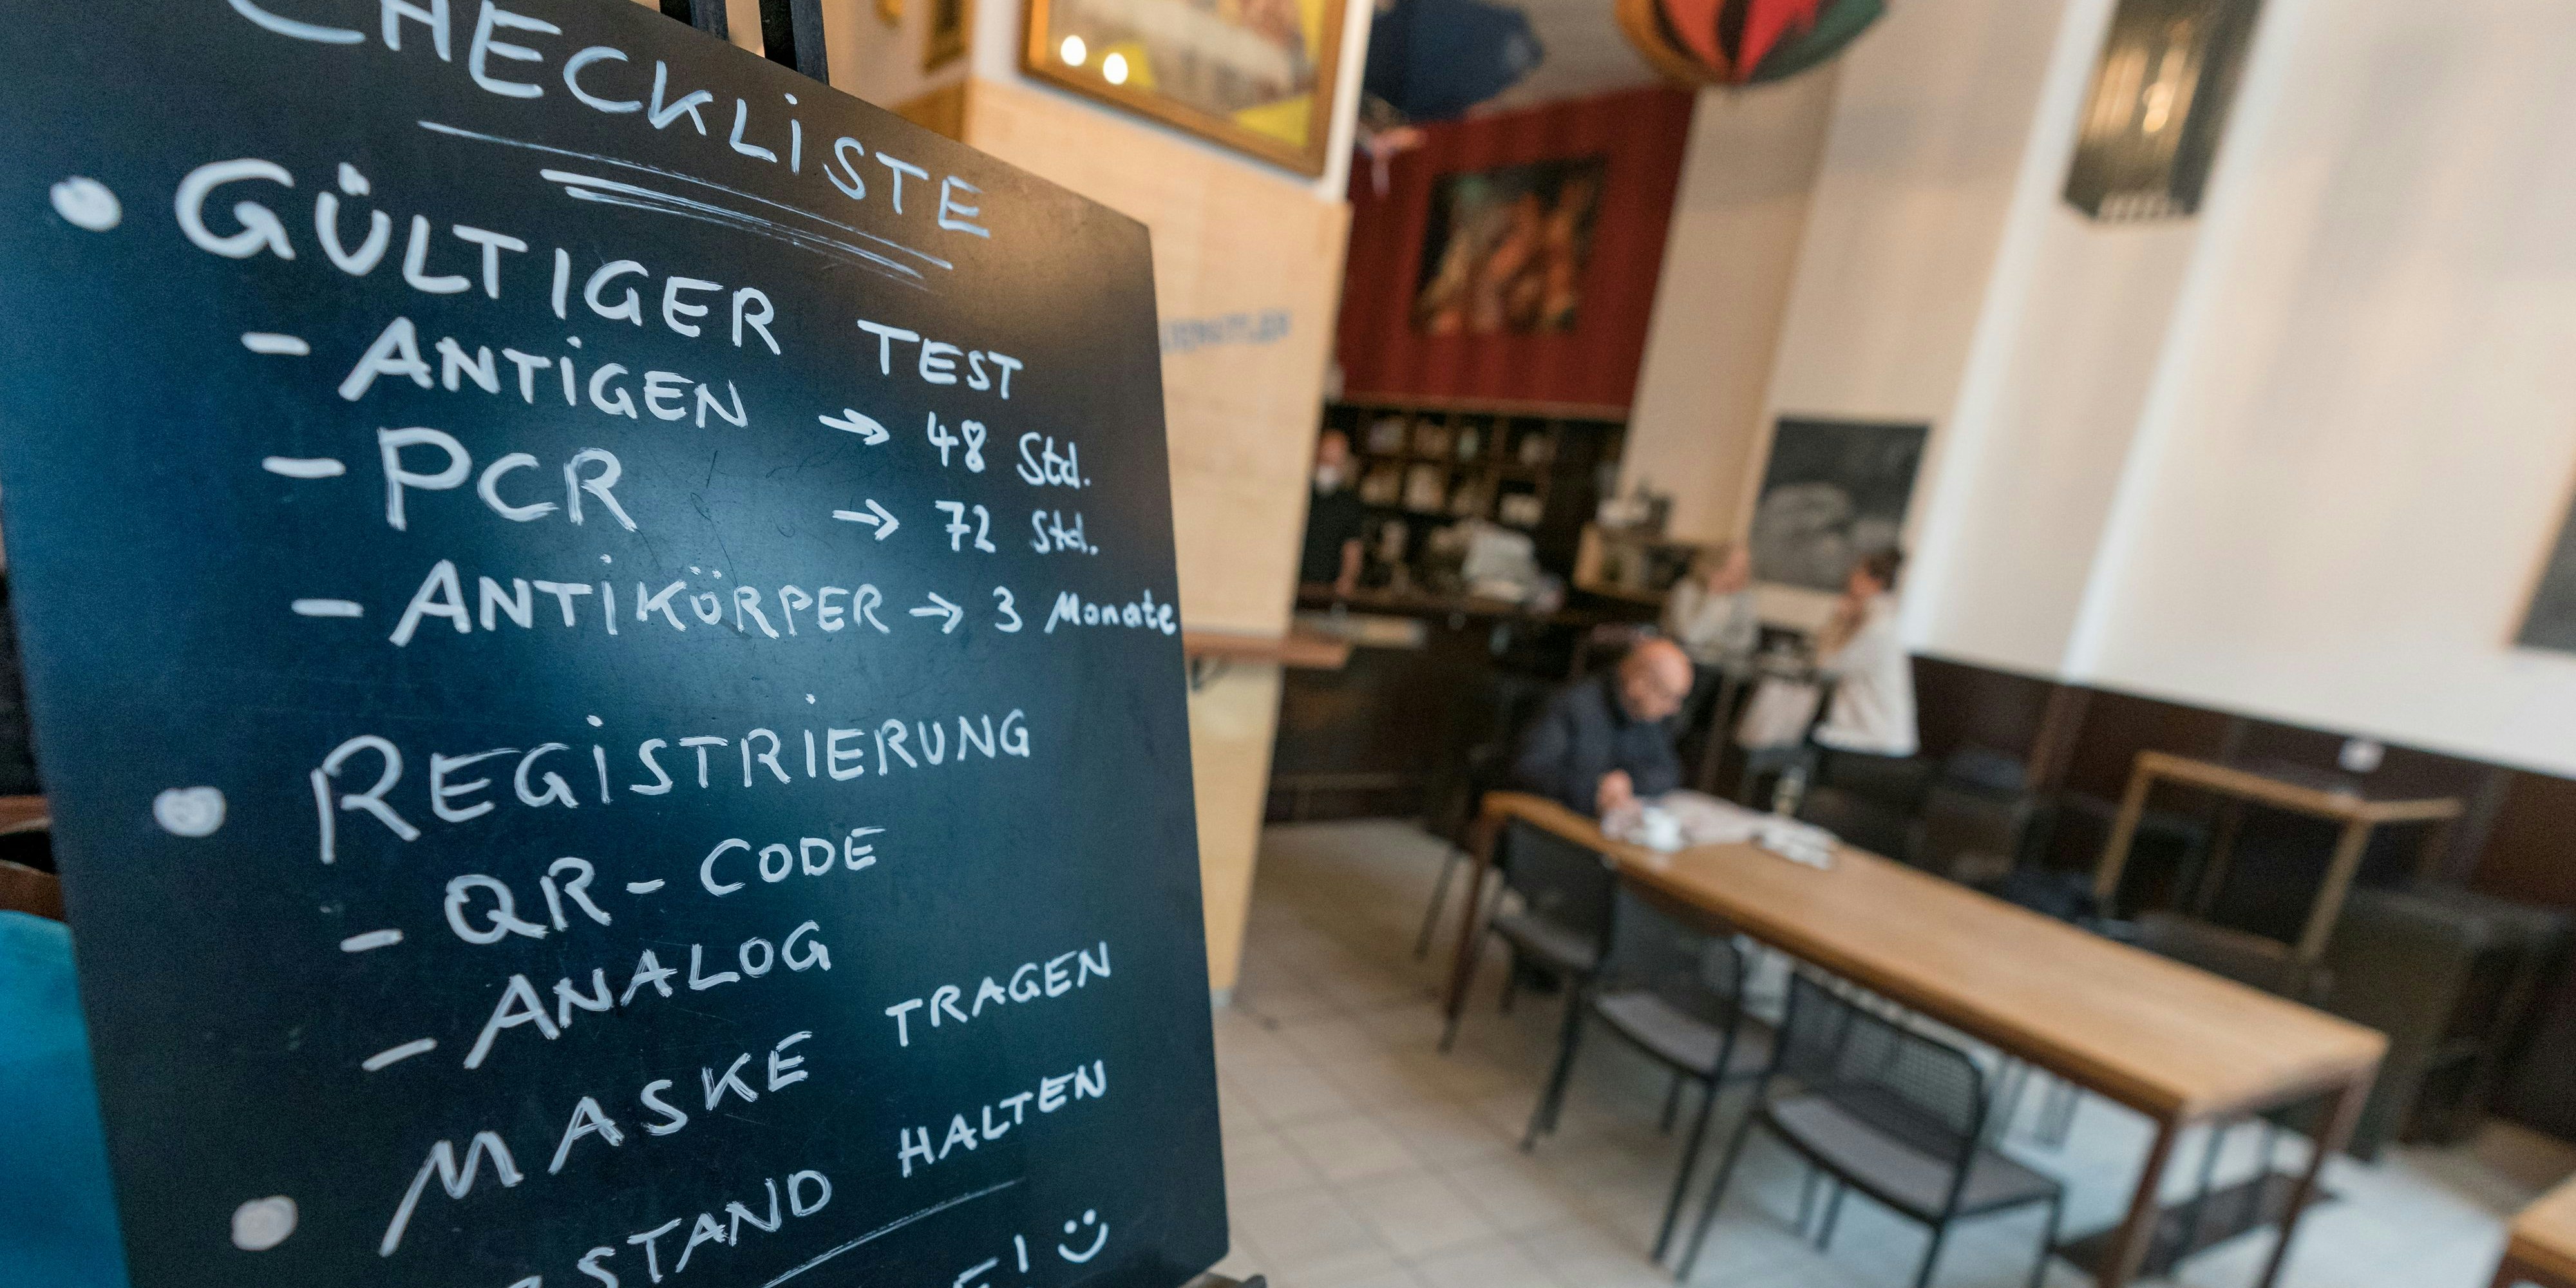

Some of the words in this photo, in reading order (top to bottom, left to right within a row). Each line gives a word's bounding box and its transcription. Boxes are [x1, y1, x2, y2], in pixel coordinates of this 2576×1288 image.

[175, 158, 781, 355] GÜLTIGER
[857, 319, 1023, 399] TEST
[377, 426, 639, 533] PCR
[934, 499, 996, 553] 72
[1030, 510, 1099, 556] Std.
[926, 411, 987, 473] 48
[1016, 431, 1092, 489] Std.
[992, 585, 1023, 633] 3
[1043, 589, 1177, 636] Monate
[464, 920, 831, 1070] ANALOG
[379, 1030, 813, 1258] MASKE
[886, 941, 1112, 1048] TRAGEN
[506, 1170, 832, 1288] STAND
[897, 1059, 1107, 1178] HALTEN
